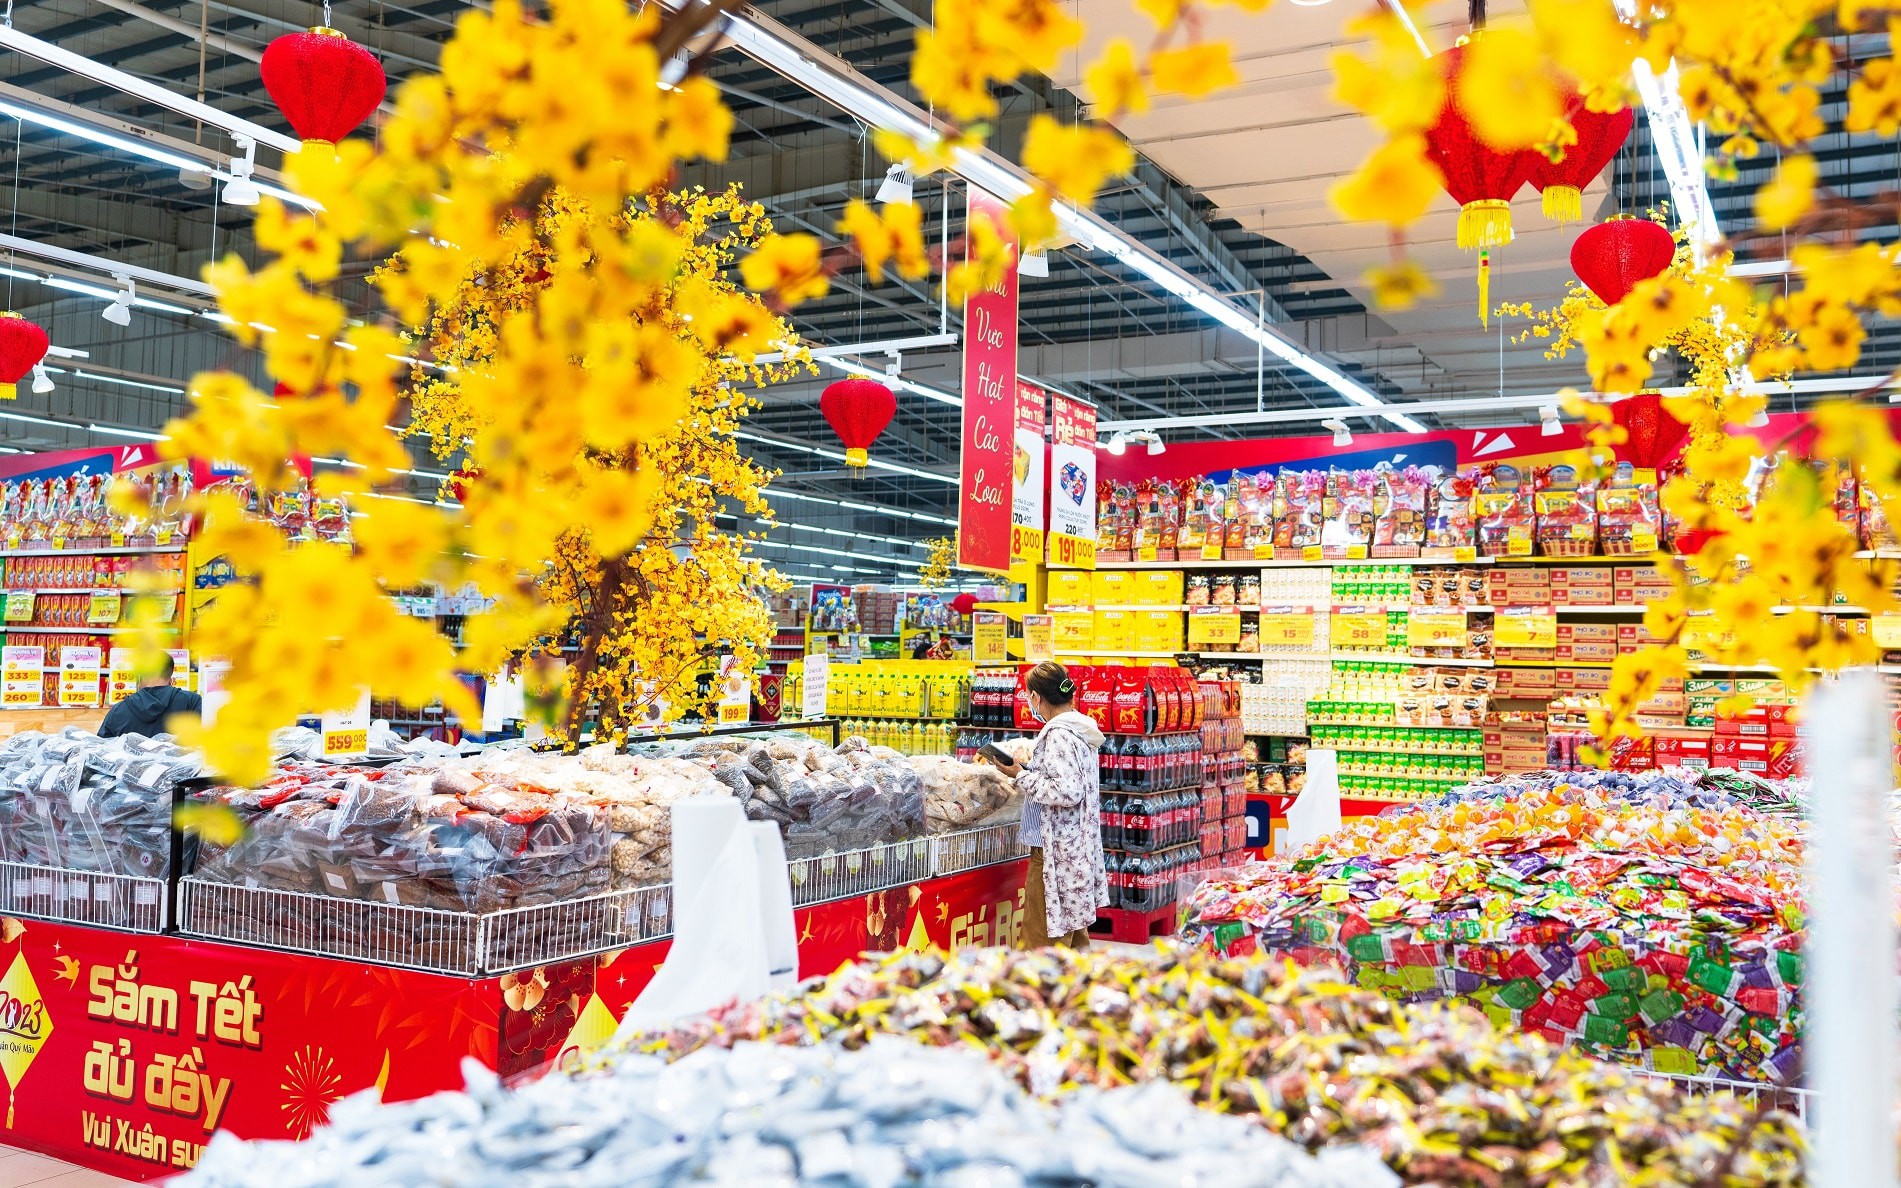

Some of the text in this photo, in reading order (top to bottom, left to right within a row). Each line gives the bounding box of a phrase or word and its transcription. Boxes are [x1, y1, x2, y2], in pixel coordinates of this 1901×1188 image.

[976, 306, 1004, 351] Vực
[977, 361, 1004, 404] Hạt
[973, 415, 1000, 453] Các
[1056, 415, 1074, 446] Rẻ
[970, 468, 1004, 512] Loại
[1011, 527, 1040, 555] 8.000
[1058, 536, 1093, 564] 191.000
[98, 609, 111, 617] 107
[1065, 626, 1078, 635] 75
[1208, 628, 1224, 638] 33
[1282, 629, 1296, 639] 15
[1352, 629, 1369, 639] 58
[1432, 630, 1448, 640] 91
[1528, 631, 1537, 641] 7
[8, 672, 29, 680] 333
[69, 672, 86, 680] 125
[5, 694, 28, 702] 260
[67, 693, 85, 701] 175
[724, 708, 738, 720] 199
[328, 734, 353, 751] 559
[949, 904, 989, 950] Giá
[87, 949, 263, 1046] Sắm Tết
[83, 1038, 231, 1132] đủ đầy
[81, 1109, 112, 1149] Vui
[115, 1115, 167, 1163] Xuân
